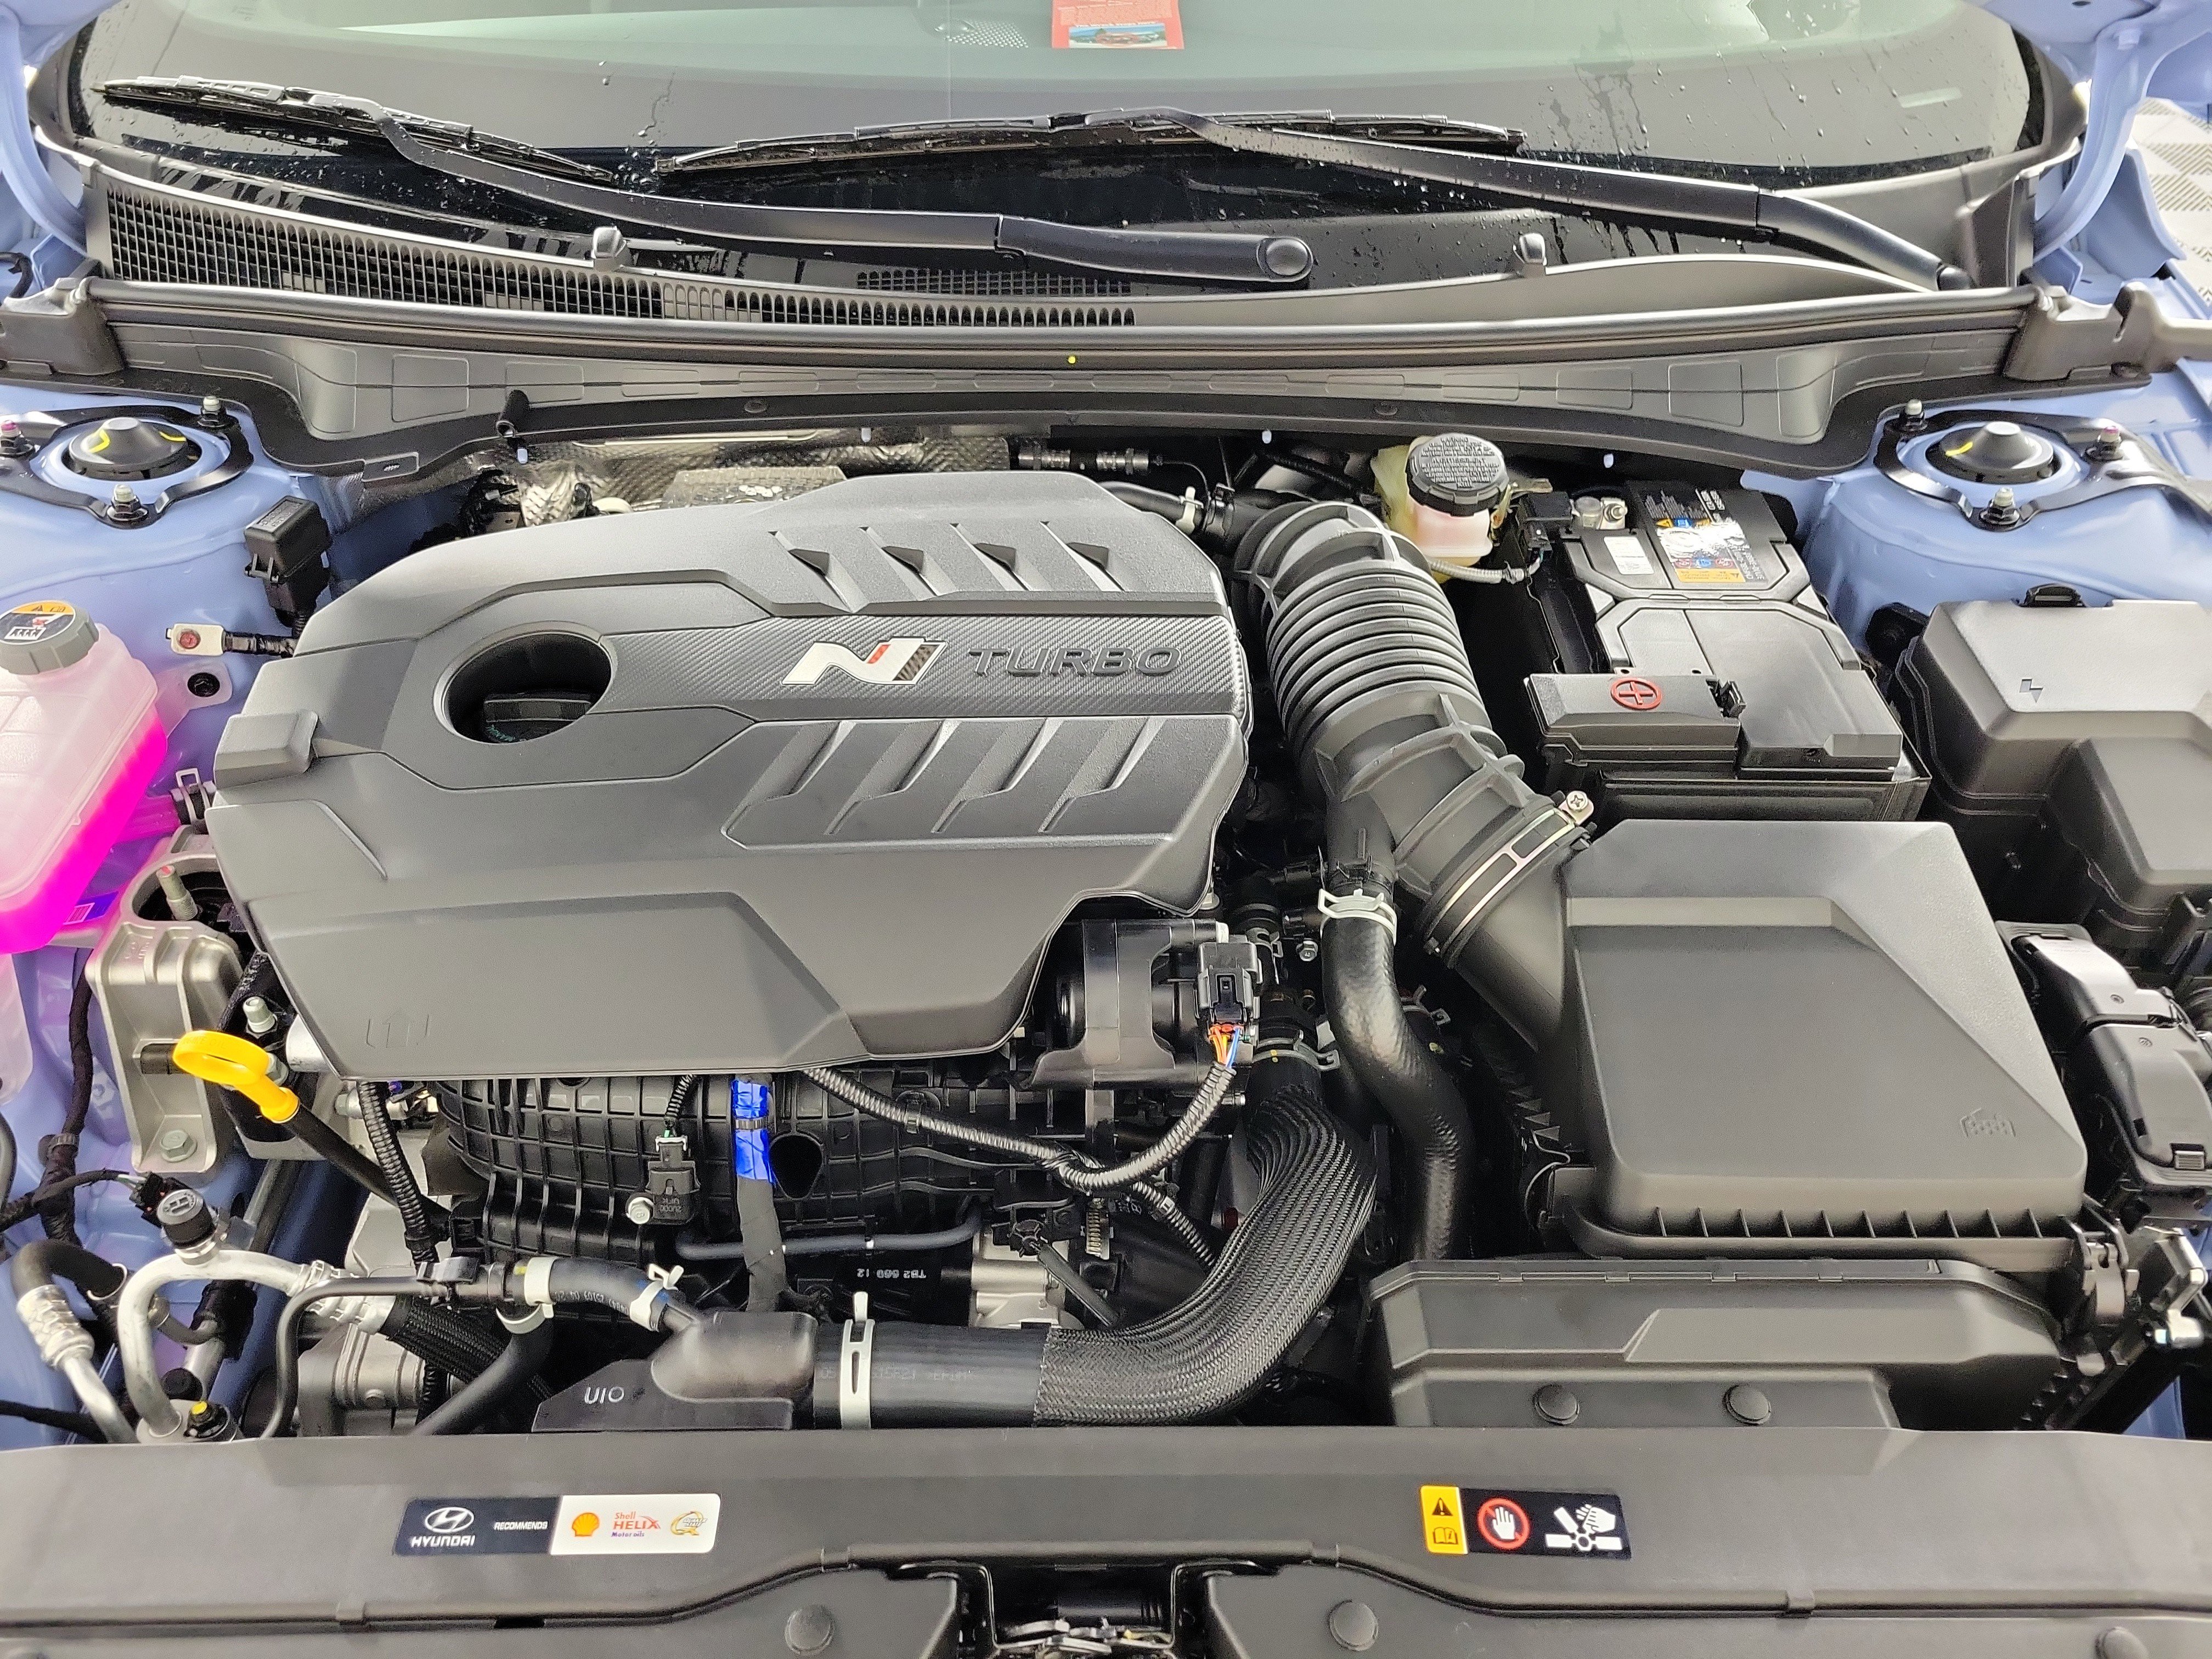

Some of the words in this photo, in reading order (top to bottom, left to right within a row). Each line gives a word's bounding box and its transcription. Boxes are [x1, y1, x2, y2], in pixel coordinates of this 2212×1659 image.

[968, 647, 1182, 676] TURBO
[615, 1511, 636, 1520] Shell
[613, 1520, 660, 1530] HELIX
[411, 1535, 476, 1548] HYUNDAI
[494, 1521, 548, 1531] RECOMMENDS
